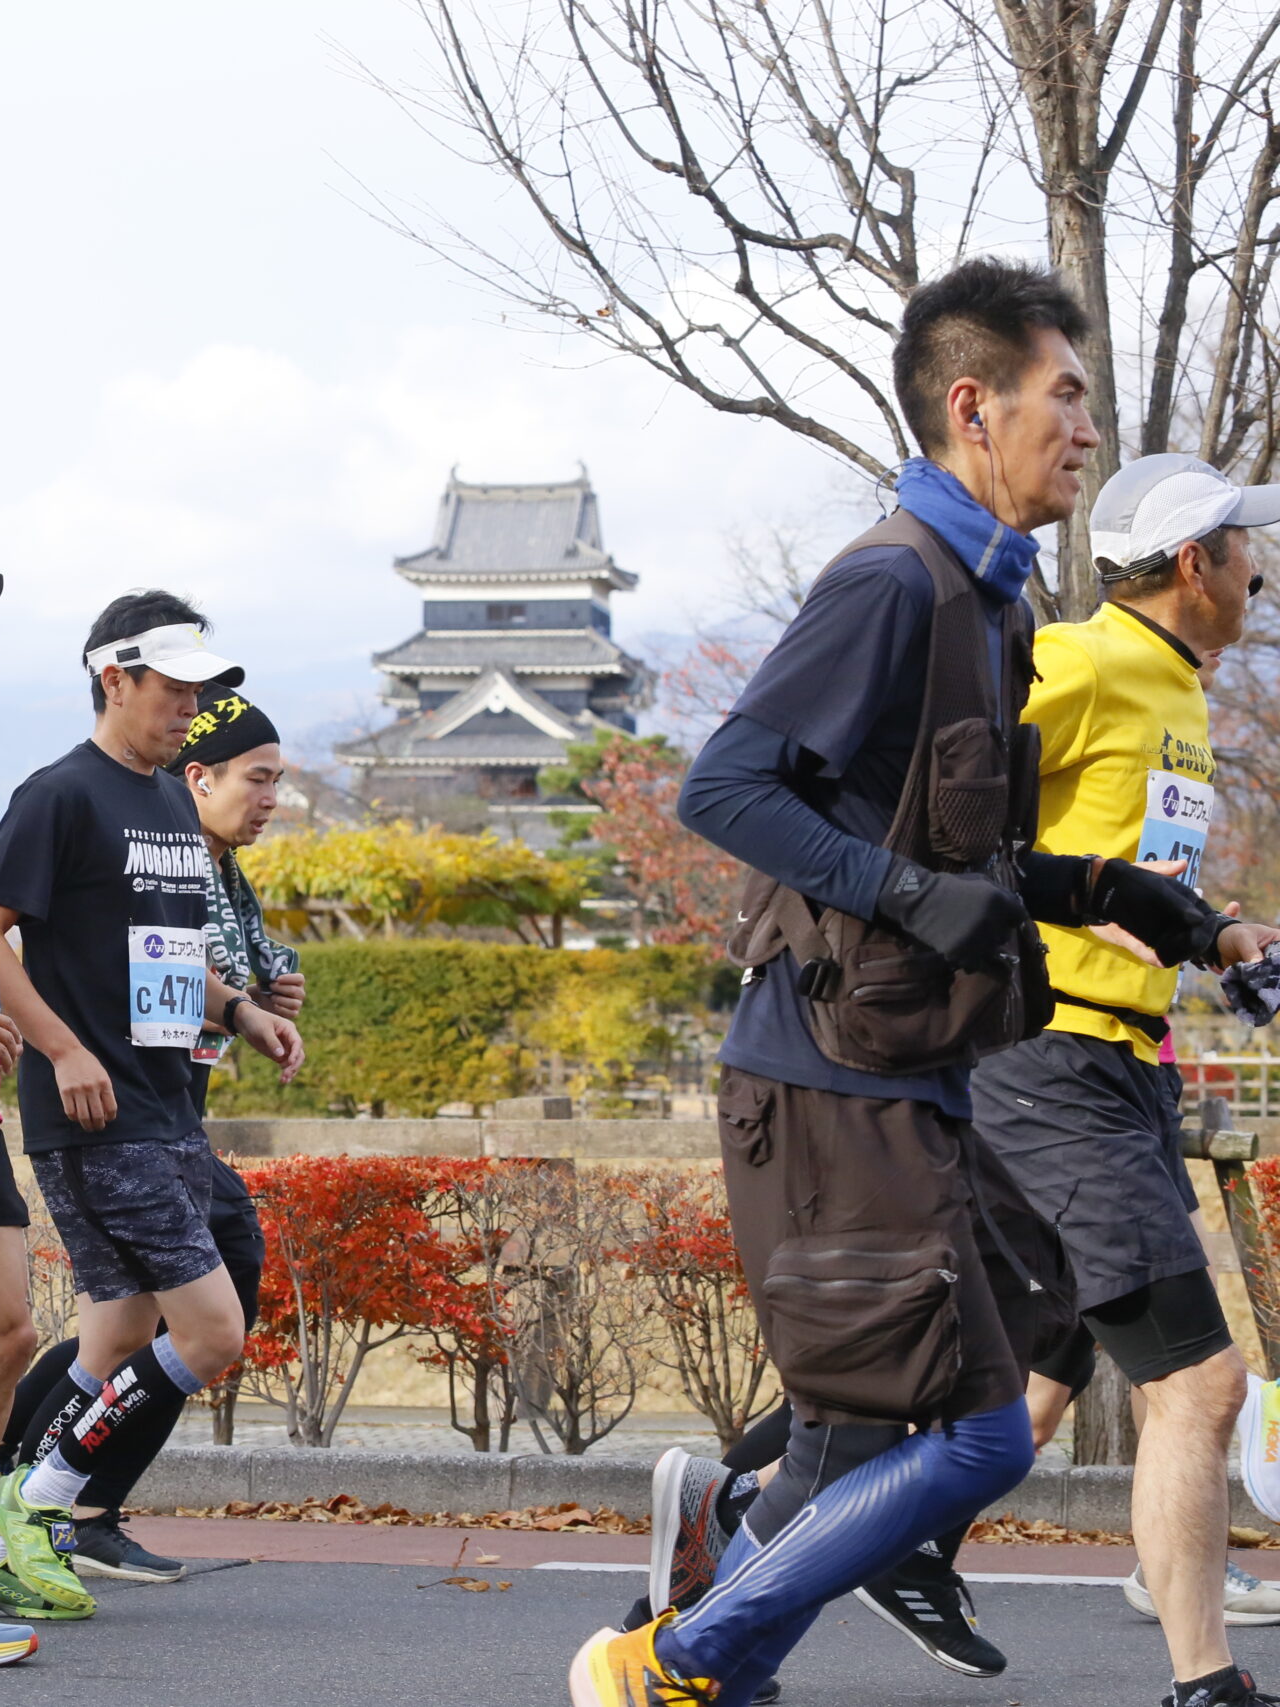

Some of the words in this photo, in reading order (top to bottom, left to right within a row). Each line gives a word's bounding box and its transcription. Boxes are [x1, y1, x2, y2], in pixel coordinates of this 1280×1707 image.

[123, 841, 206, 878] MURAKAM
[136, 986, 152, 1015] C
[158, 974, 204, 1019] 4710
[72, 1365, 139, 1442] IRONMAN
[80, 1418, 112, 1454] 70.3
[103, 1388, 147, 1422] Taiwan
